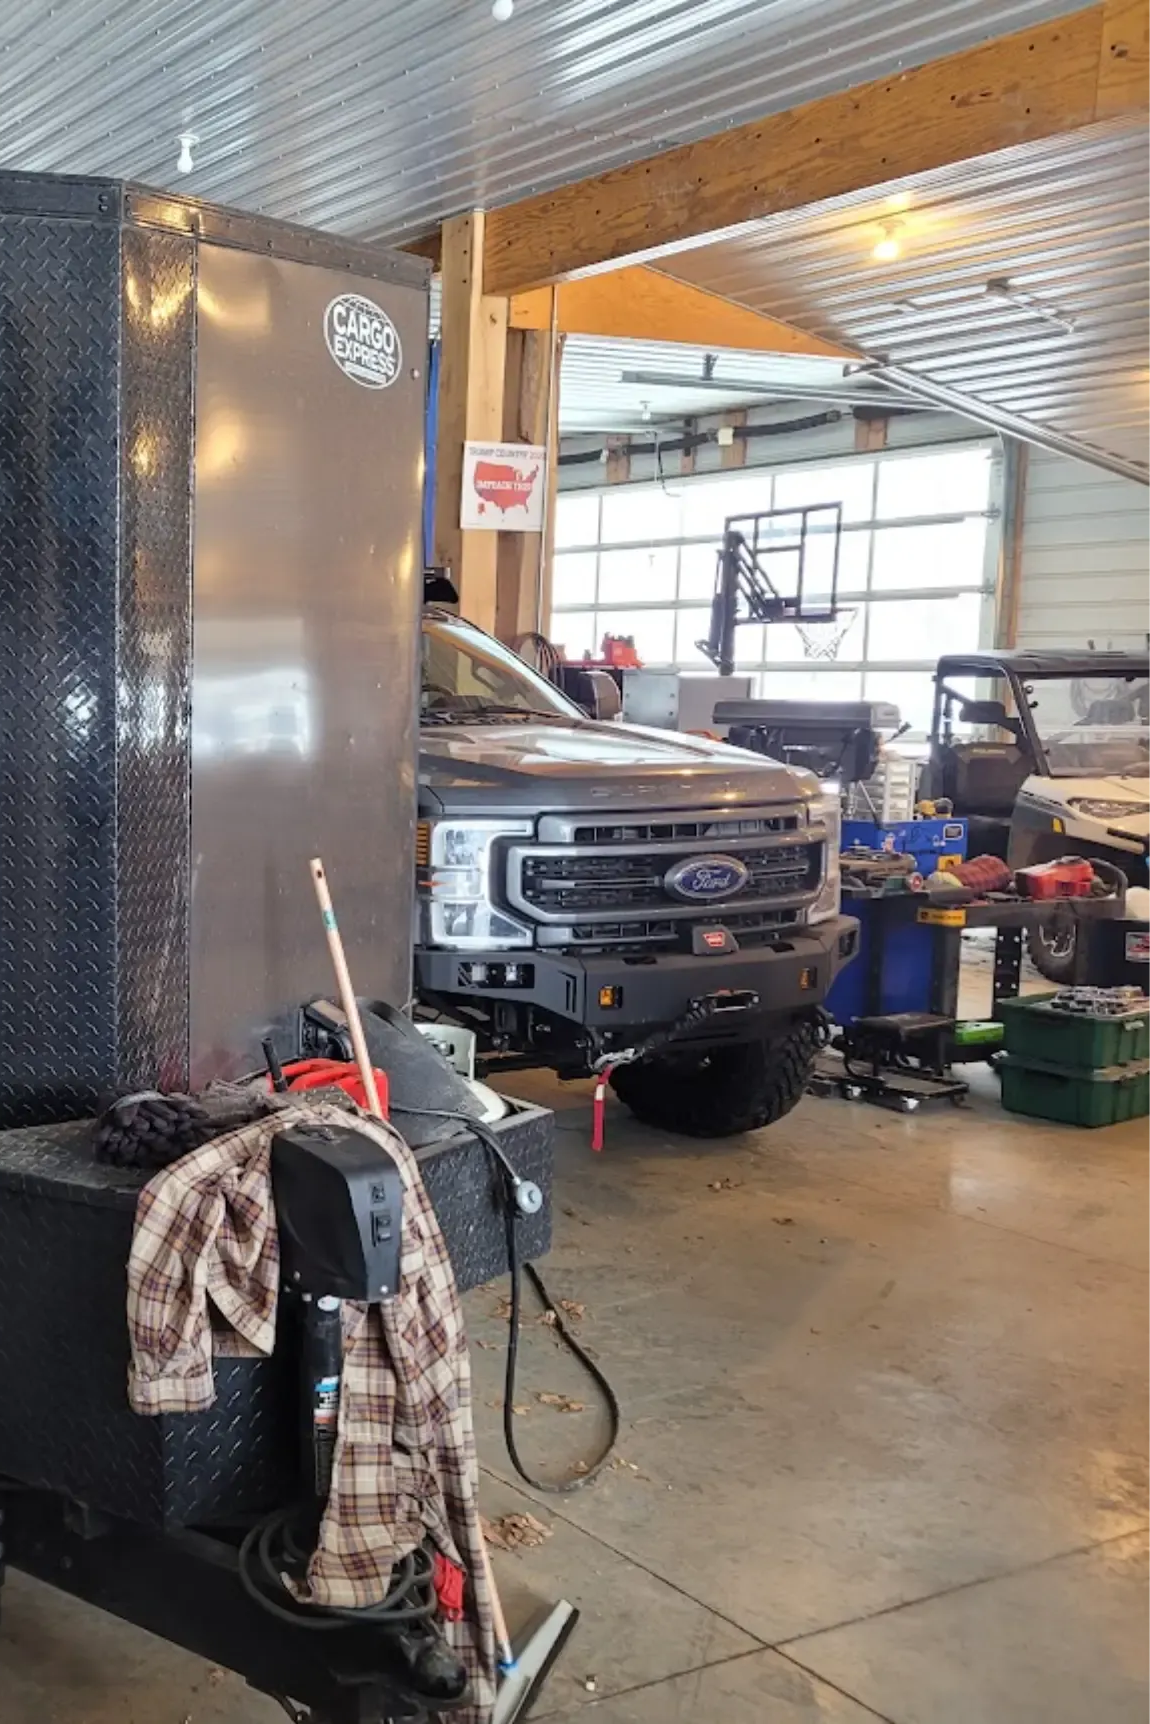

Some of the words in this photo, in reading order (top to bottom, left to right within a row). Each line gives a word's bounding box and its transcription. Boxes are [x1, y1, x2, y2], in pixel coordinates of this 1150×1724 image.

[333, 304, 395, 355] CARGO
[334, 334, 396, 377] EXPRESS
[692, 869, 732, 891] Ford
